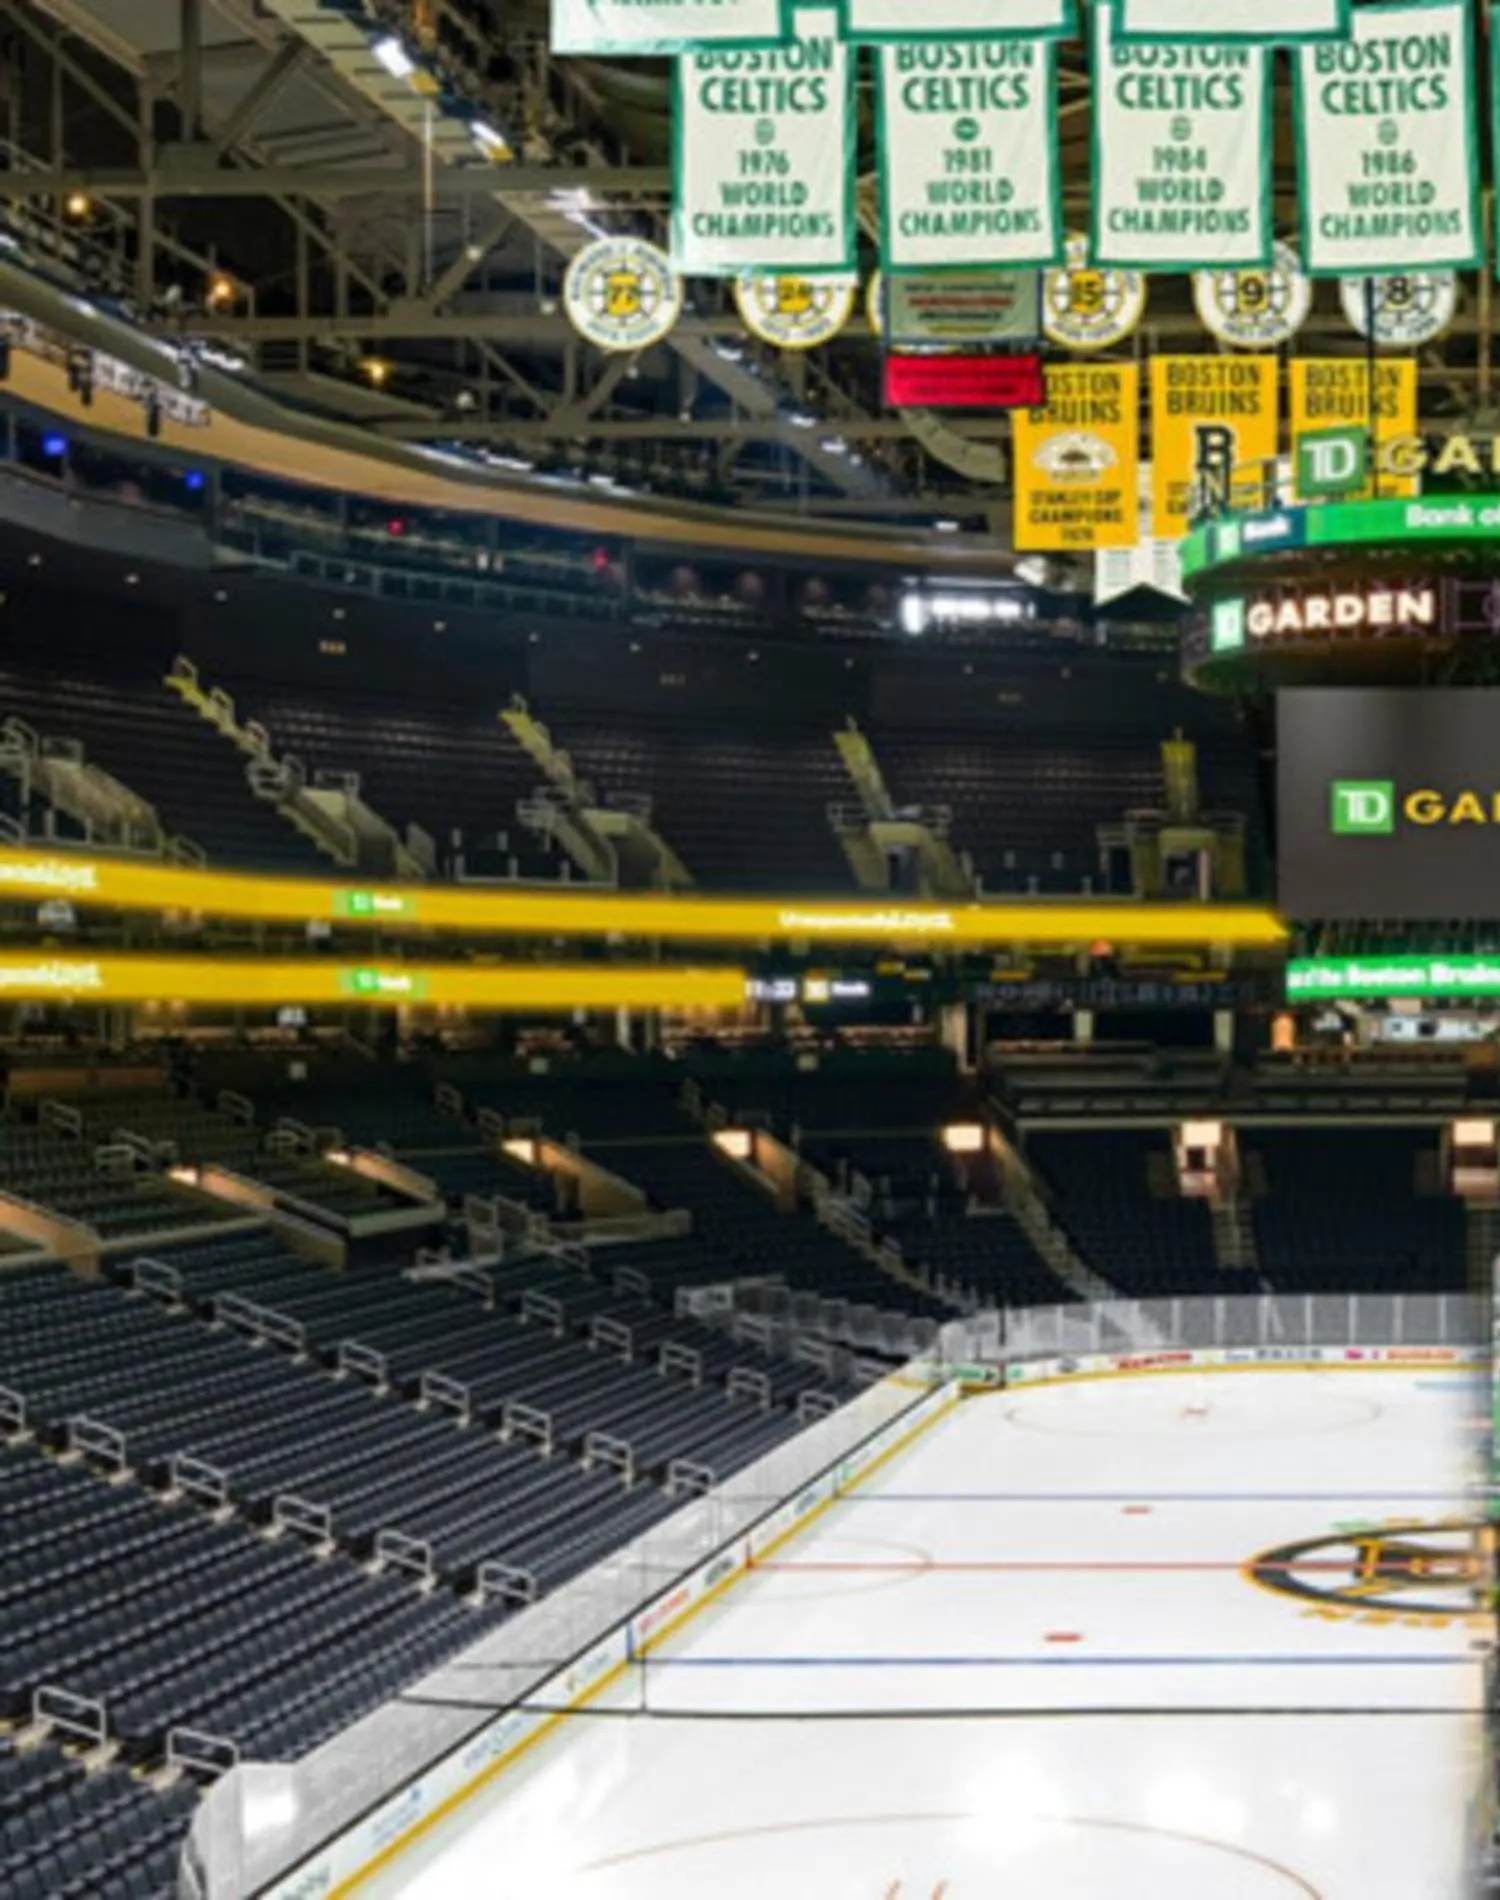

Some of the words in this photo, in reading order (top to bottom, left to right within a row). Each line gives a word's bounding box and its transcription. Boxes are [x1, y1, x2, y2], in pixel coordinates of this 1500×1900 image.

[896, 41, 1034, 71] BOSTON
[1314, 33, 1450, 74] BOSTON
[700, 76, 827, 113] CELTICS
[902, 73, 1030, 112] CELTICS
[1116, 73, 1243, 110] CELTICS
[1321, 74, 1448, 115] CELTICS
[738, 149, 790, 176] 1976
[943, 148, 992, 173] 1981
[1153, 146, 1207, 173] 1984
[1360, 151, 1417, 176] 1986
[721, 179, 808, 206] WORLD
[926, 176, 1015, 204] WORLD
[1136, 177, 1225, 203] WORLD
[1346, 180, 1436, 207] WORLD
[692, 211, 835, 237] CHAMPIONS
[899, 207, 1042, 236] CHAMPIONS
[1107, 207, 1250, 233] CHAMPIONS
[1319, 209, 1462, 239] CHAMPIONS
[1241, 275, 1264, 306] 9
[1386, 275, 1409, 304] 8
[1045, 372, 1121, 397] OSTON
[1167, 363, 1260, 386] BOSTON
[1167, 390, 1260, 415] BRUINS
[1302, 440, 1357, 482] TD
[1405, 504, 1472, 528] Bank
[1247, 591, 1434, 637] GARDEN
[1338, 790, 1389, 824] TD
